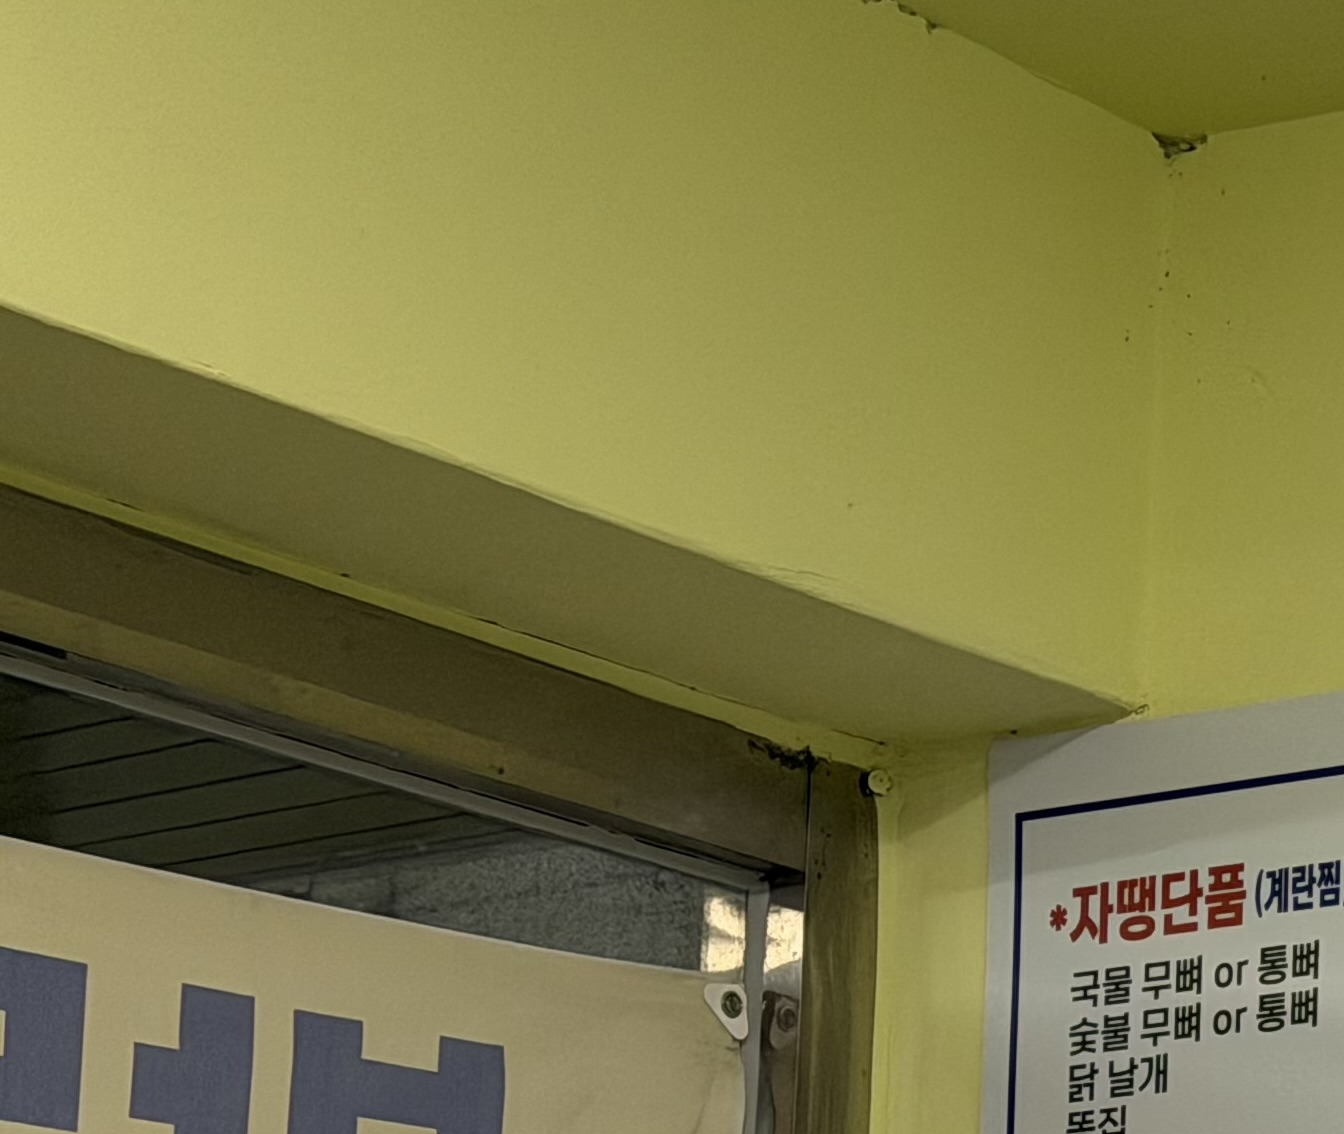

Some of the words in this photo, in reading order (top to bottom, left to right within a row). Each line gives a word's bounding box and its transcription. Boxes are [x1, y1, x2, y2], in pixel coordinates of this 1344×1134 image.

[1071, 966, 1132, 1007] 국물
[1142, 955, 1202, 1000] 무뼈
[1215, 960, 1249, 988] or
[1258, 940, 1319, 985] 통뼈
[1069, 1012, 1130, 1056] 숯불
[1141, 1002, 1201, 1046] 무뼈
[1213, 1007, 1247, 1035] or
[1256, 987, 1318, 1032] 통뼈
[1069, 1062, 1099, 1103] 닭
[1109, 1053, 1168, 1098] 날개
